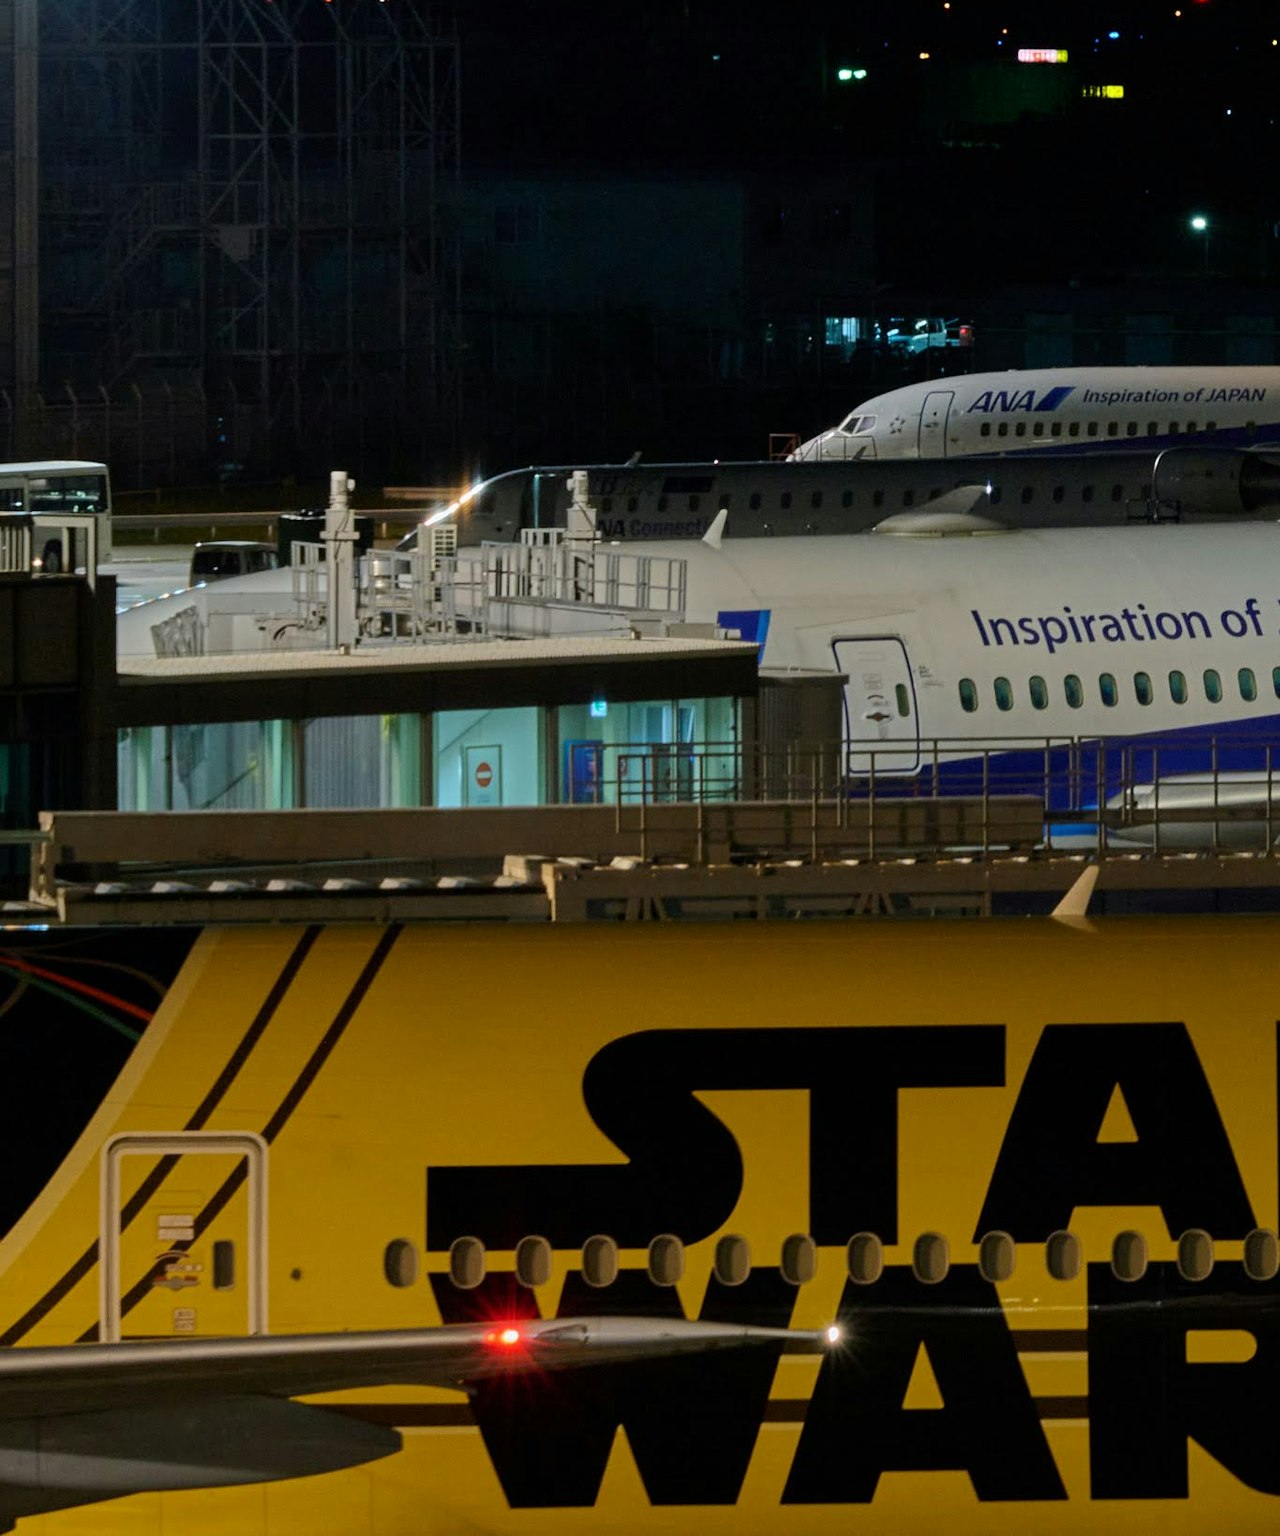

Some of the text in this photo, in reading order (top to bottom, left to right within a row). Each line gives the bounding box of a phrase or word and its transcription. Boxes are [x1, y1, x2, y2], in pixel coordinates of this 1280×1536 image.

[967, 386, 1266, 413] ANA Inspiration of JAPAN
[971, 604, 1214, 654] Inspiration
[1221, 597, 1265, 637] of
